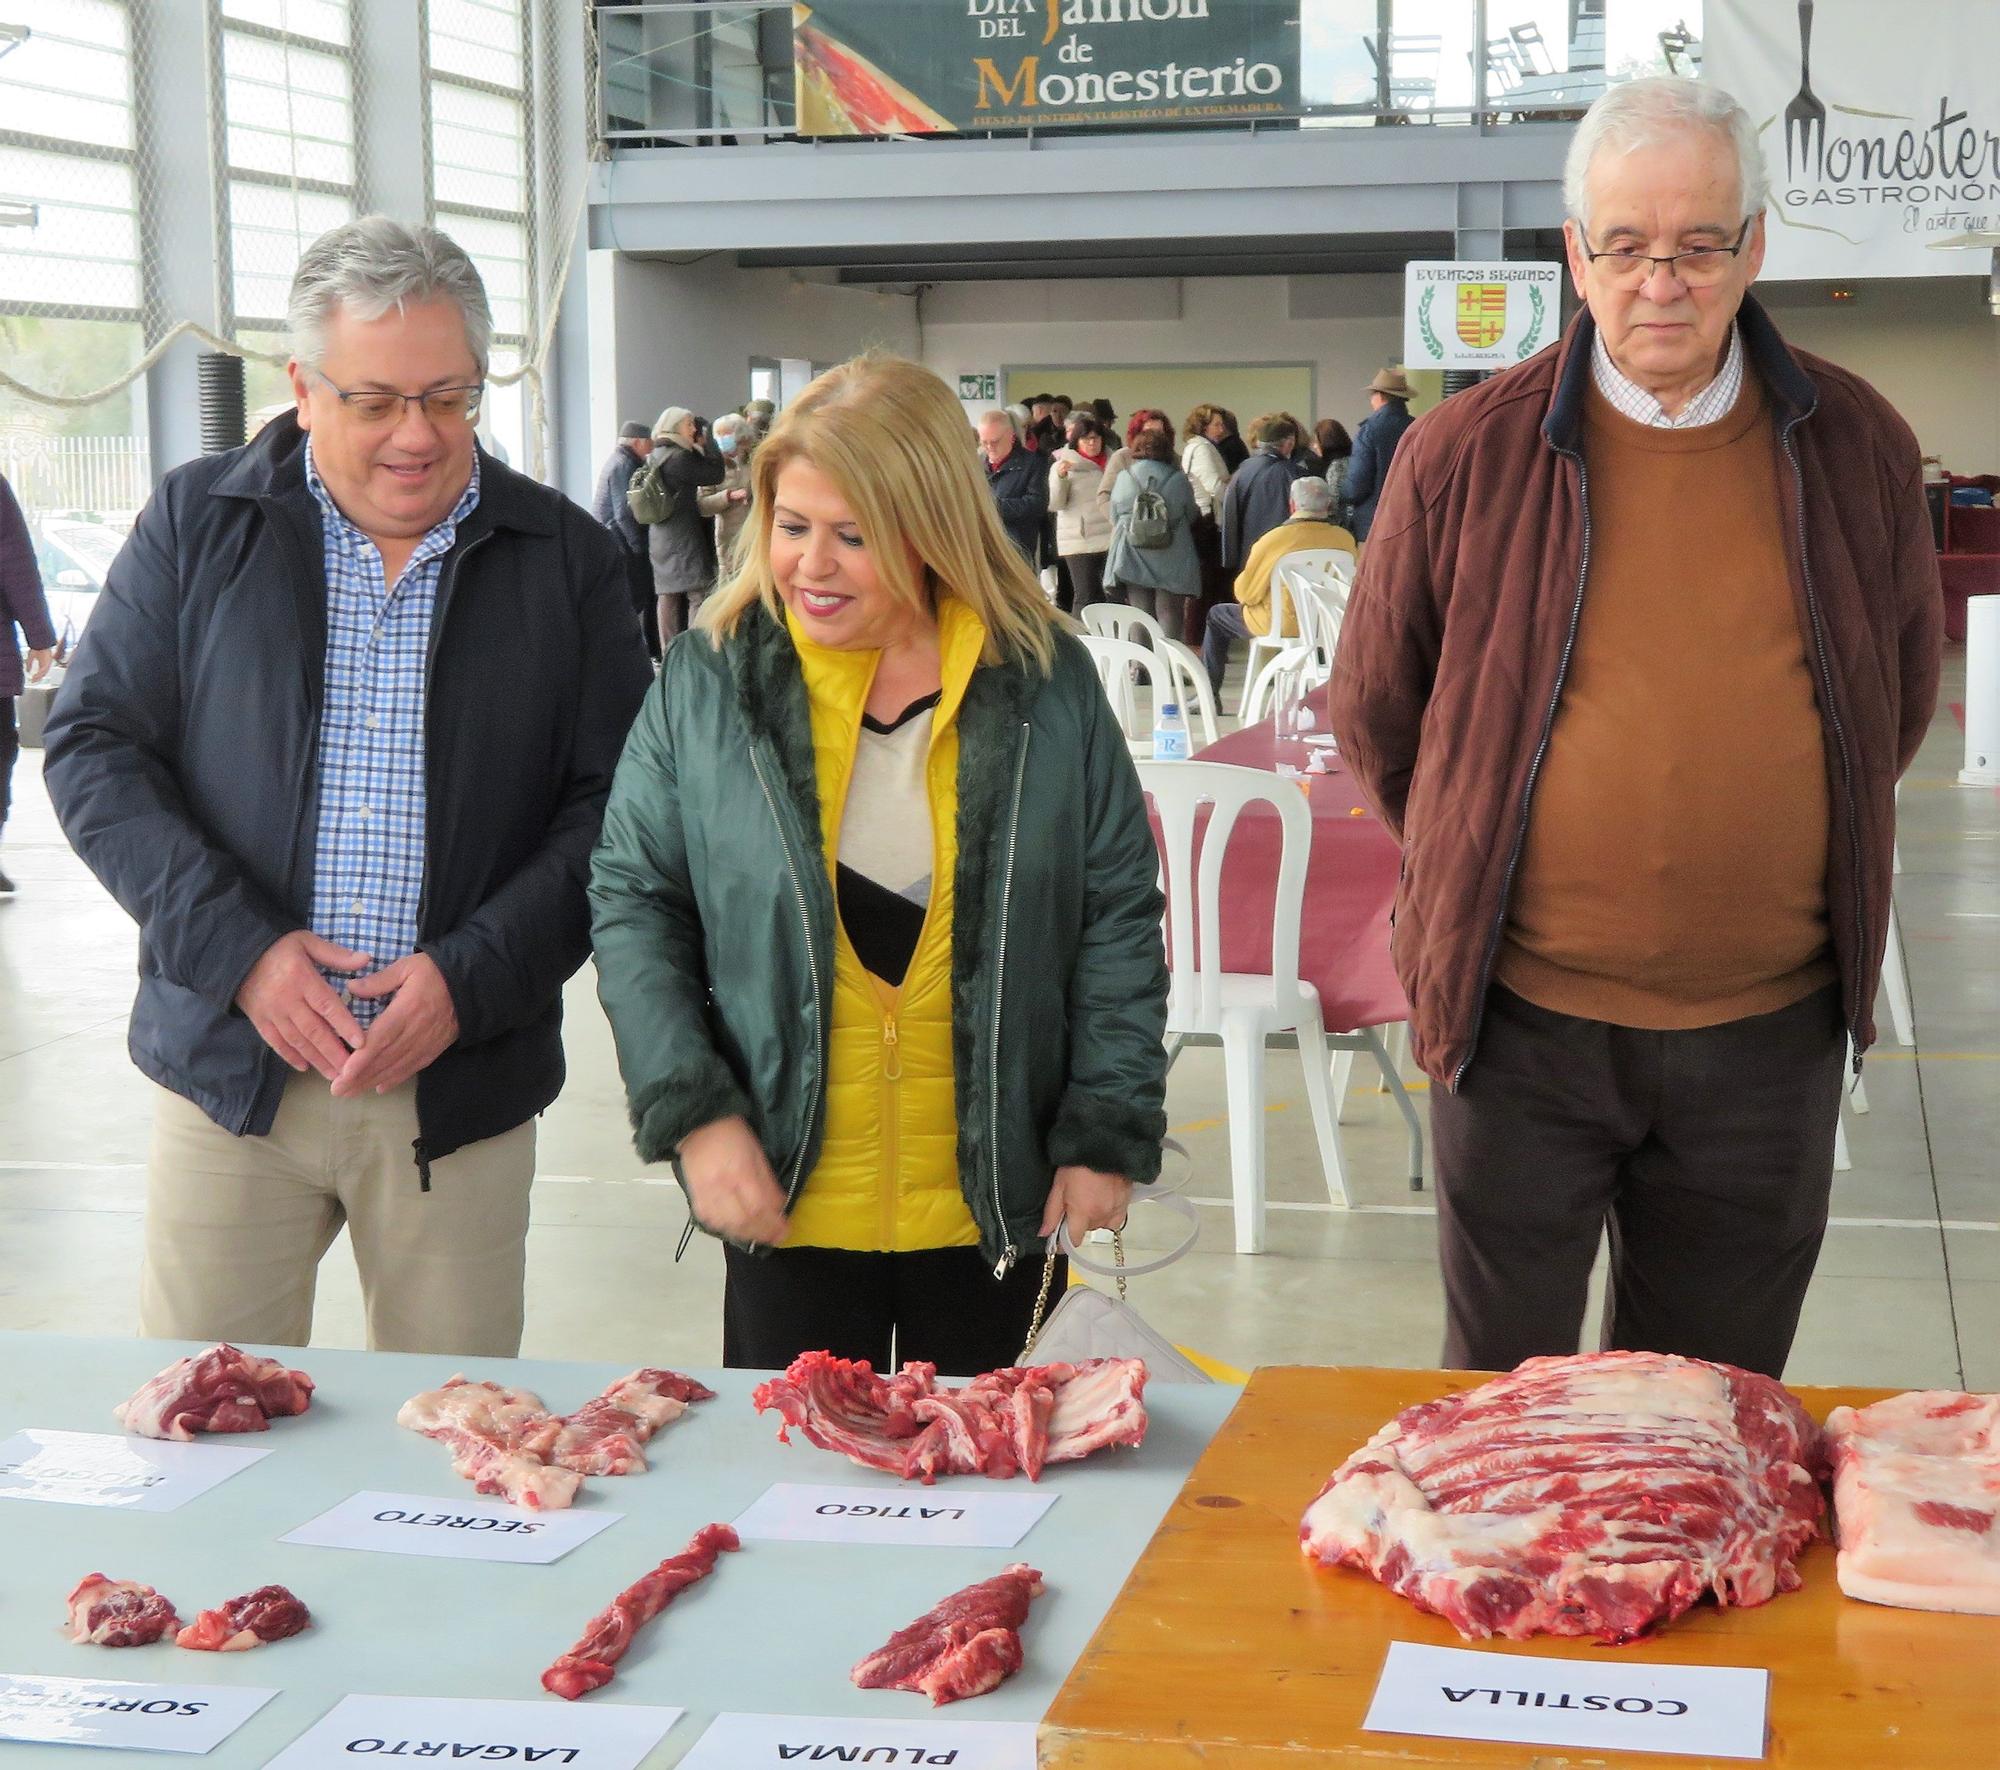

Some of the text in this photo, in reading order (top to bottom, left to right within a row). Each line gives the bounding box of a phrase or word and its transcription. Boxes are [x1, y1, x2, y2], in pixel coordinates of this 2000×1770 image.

[979, 18, 1026, 38] DEL
[1058, 33, 1094, 63] de
[973, 56, 1283, 109] Monesterio
[1903, 205, 1919, 233] El
[1964, 216, 1988, 232] que
[1416, 269, 1556, 281] EVENTOS SEGUNDO
[373, 1510, 545, 1534] SECRETO
[815, 1503, 966, 1521] LATIGO
[1441, 1686, 1689, 1716] COSTILLA
[345, 1738, 581, 1764] LAGARTO
[777, 1743, 959, 1766] PLUMA
